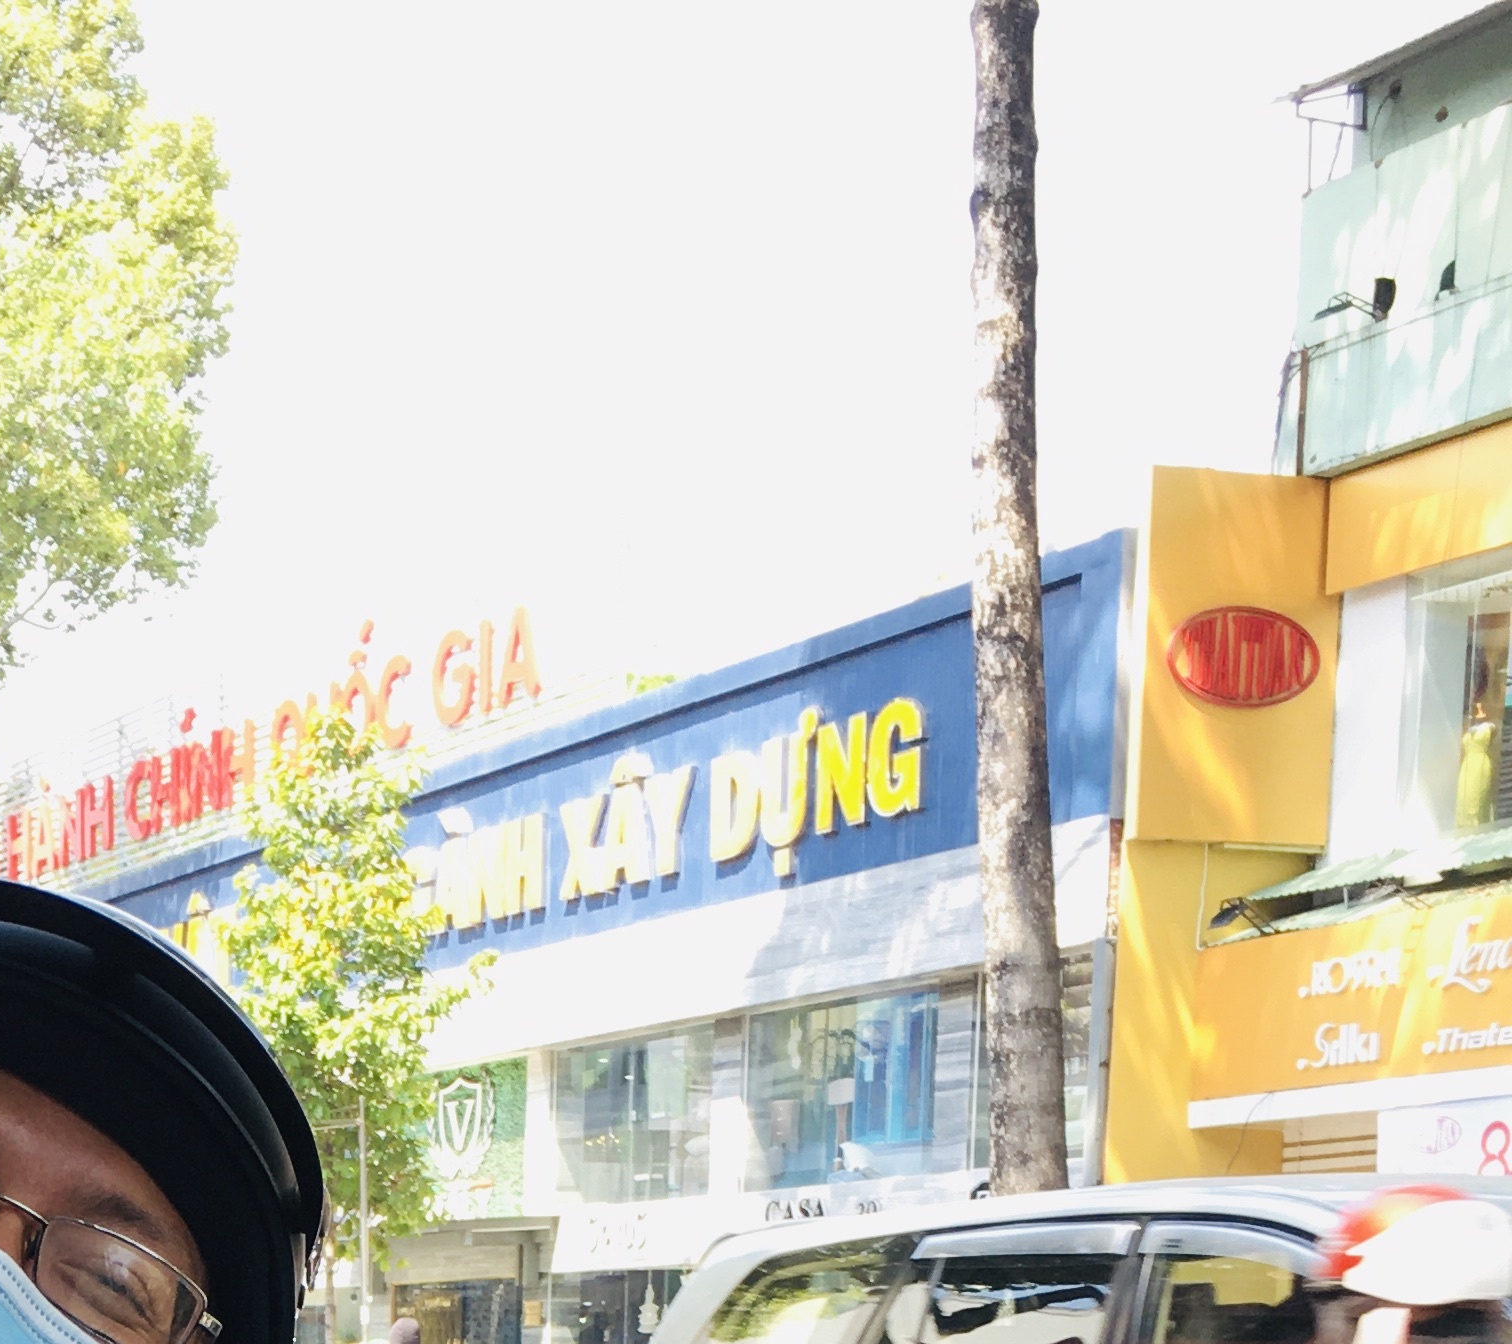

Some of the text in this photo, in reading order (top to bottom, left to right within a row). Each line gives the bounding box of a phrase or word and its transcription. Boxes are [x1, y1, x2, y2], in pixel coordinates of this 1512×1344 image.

[432, 606, 542, 727] GIA
[559, 748, 697, 901] XÂY
[710, 697, 927, 877] DỰNG
